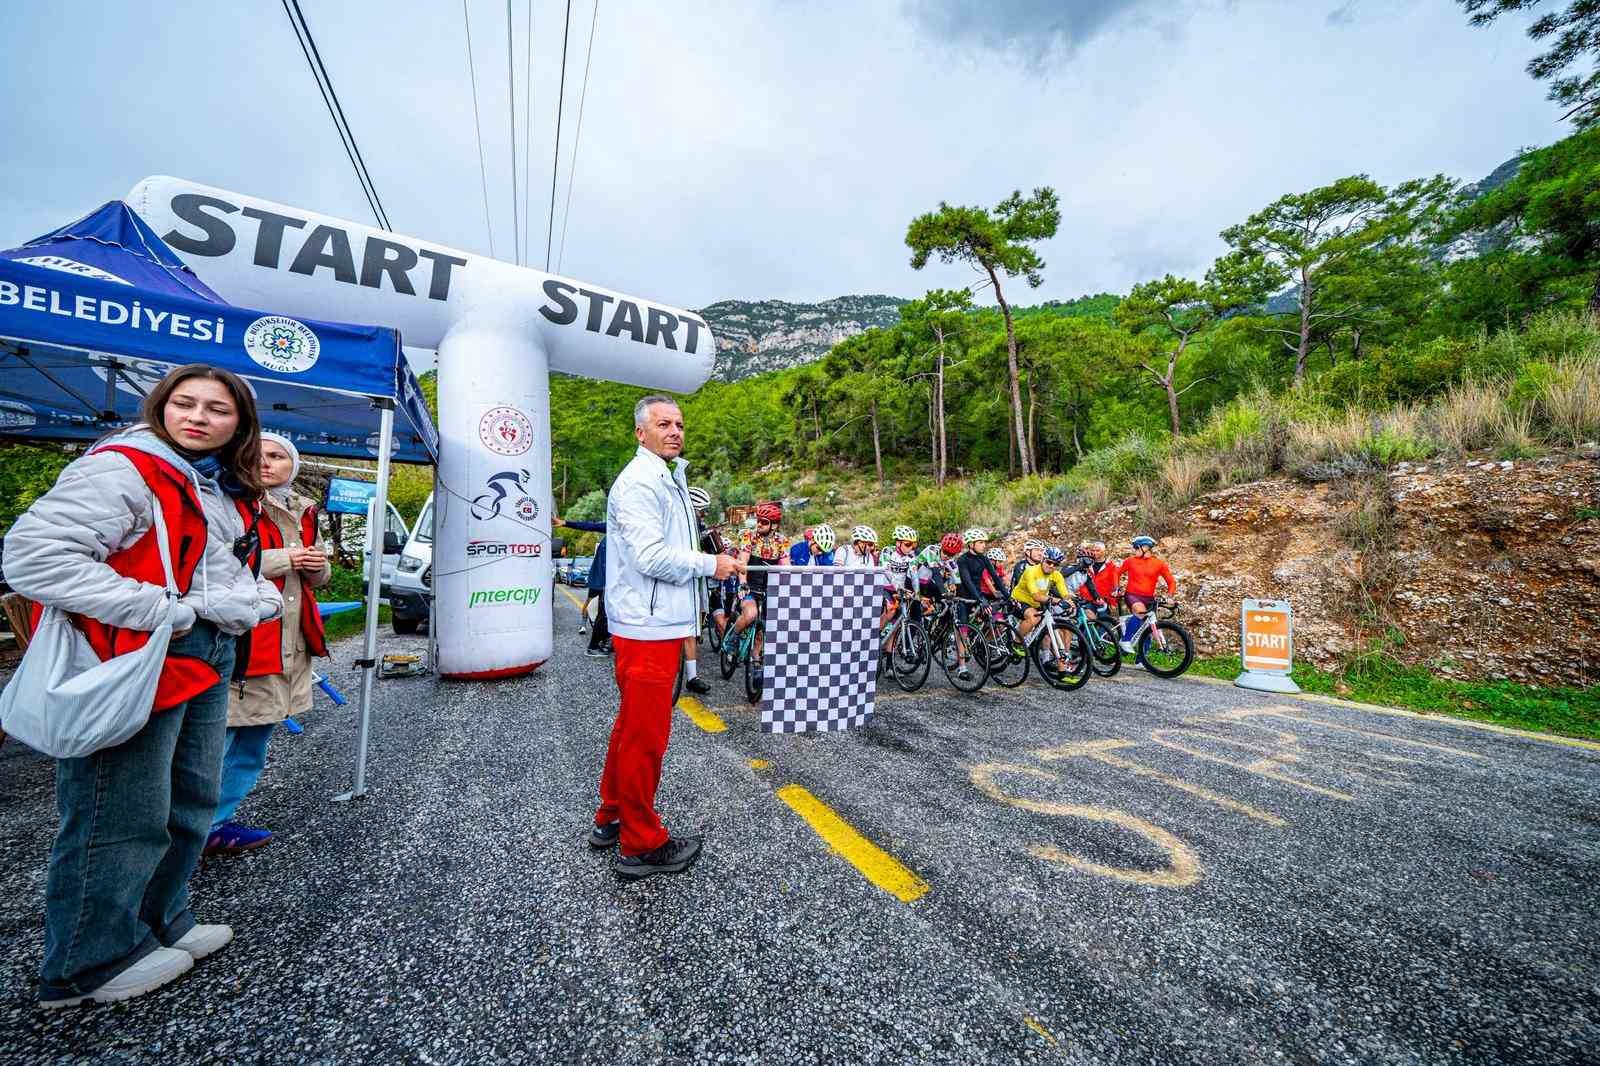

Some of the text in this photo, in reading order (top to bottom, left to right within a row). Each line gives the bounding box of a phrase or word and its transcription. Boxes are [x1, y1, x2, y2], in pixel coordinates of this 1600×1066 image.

[161, 193, 467, 302] START
[0, 281, 225, 344] BELEDİYESİ
[538, 279, 706, 355] START
[1246, 631, 1288, 650] START
